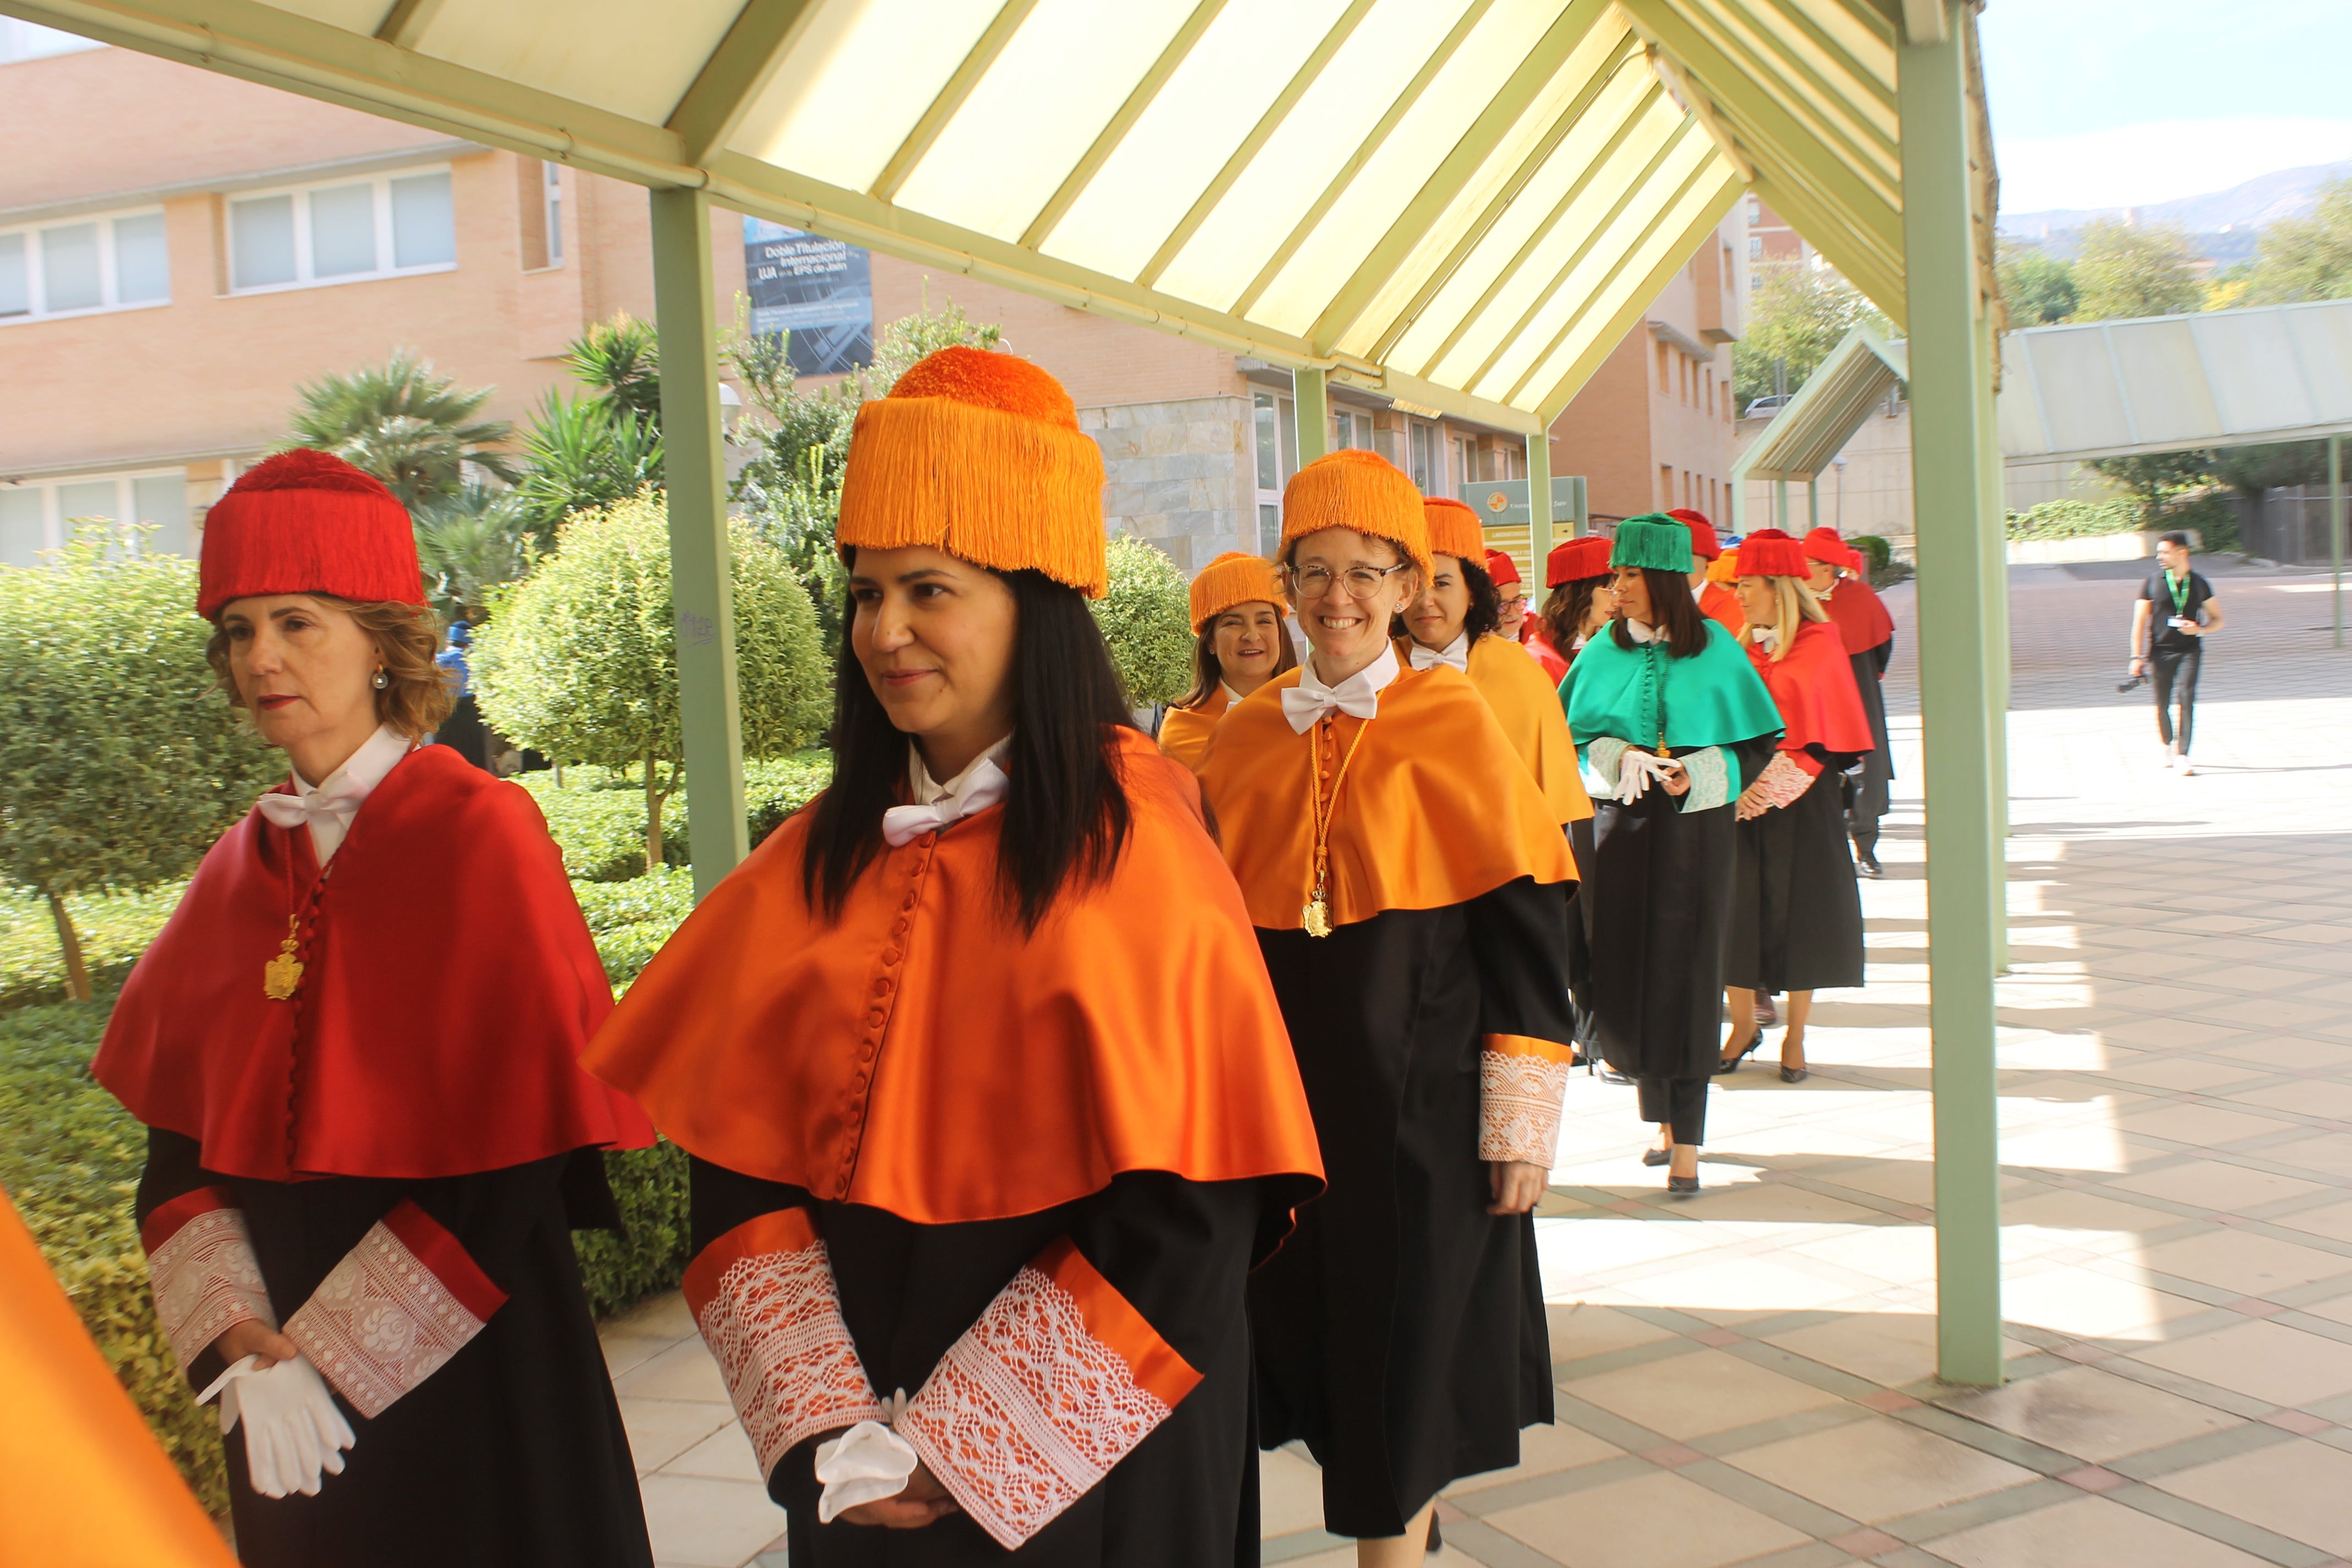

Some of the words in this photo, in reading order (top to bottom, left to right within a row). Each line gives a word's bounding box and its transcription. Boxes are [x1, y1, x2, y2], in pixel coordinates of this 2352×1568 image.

[765, 244, 795, 259] Doble
[780, 251, 847, 268] Internacional
[813, 264, 825, 274] de
